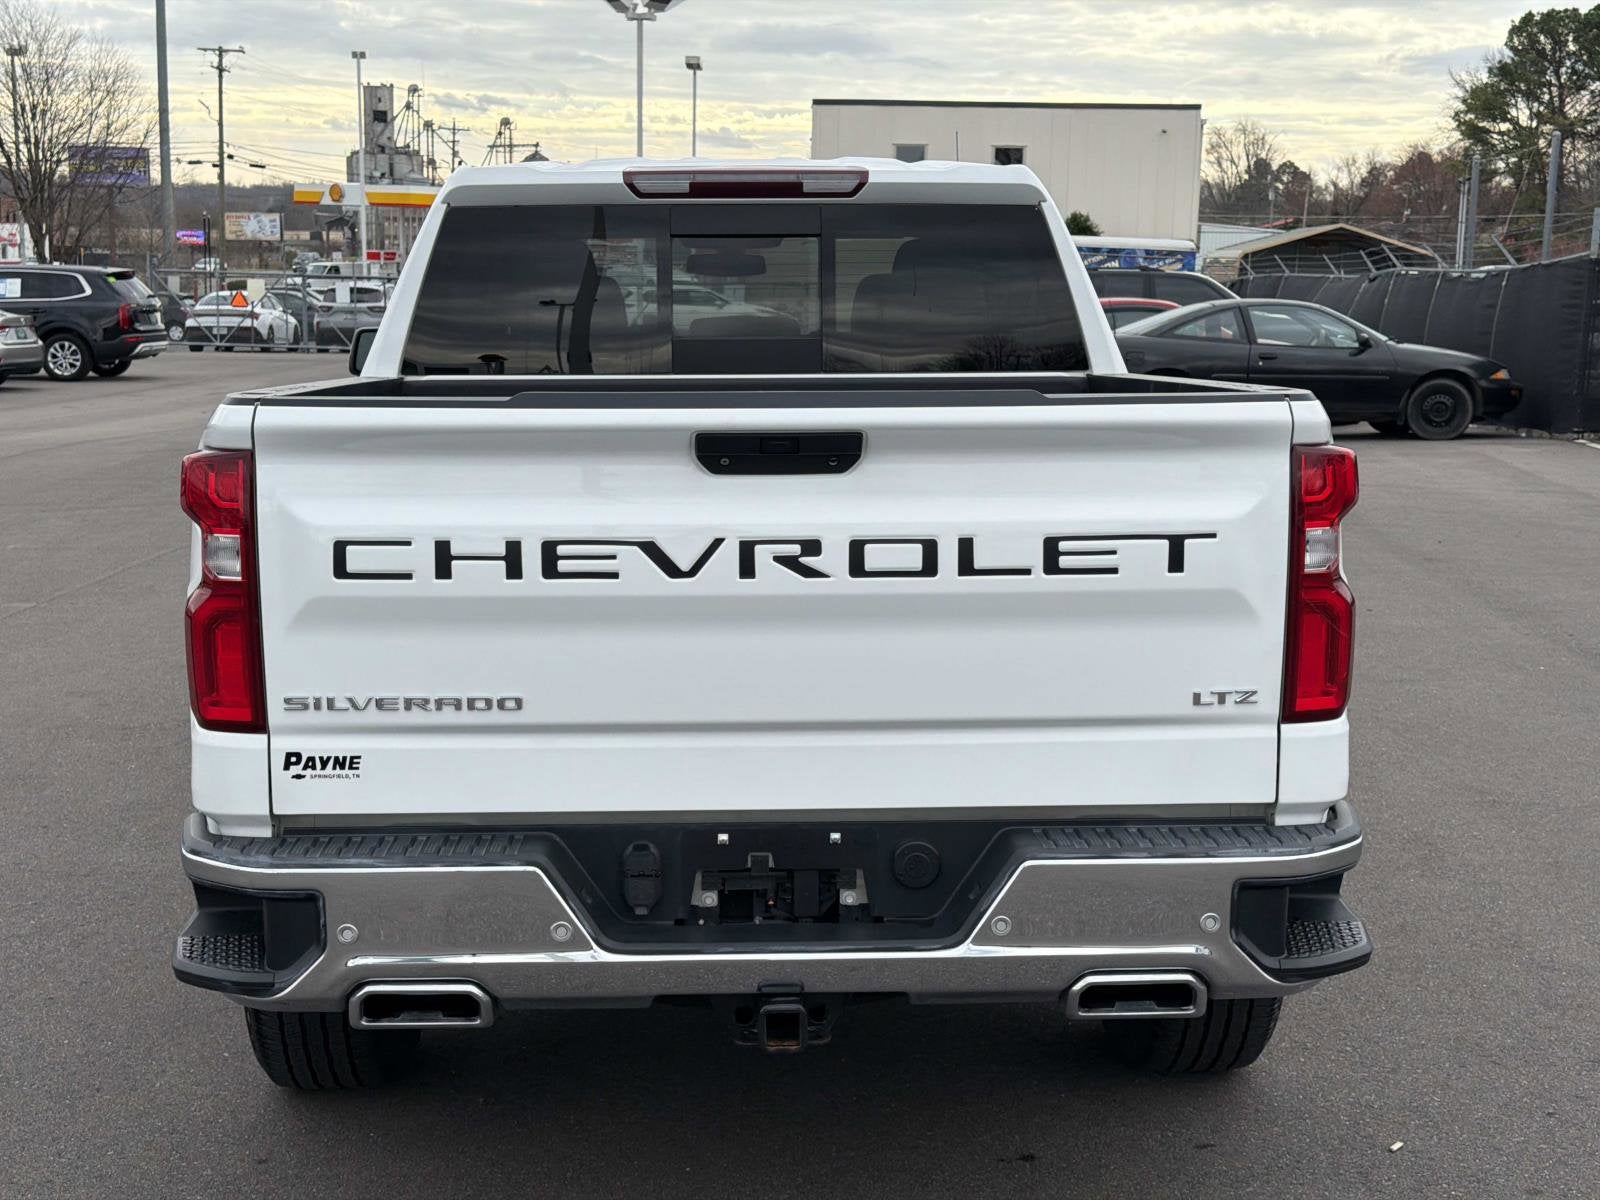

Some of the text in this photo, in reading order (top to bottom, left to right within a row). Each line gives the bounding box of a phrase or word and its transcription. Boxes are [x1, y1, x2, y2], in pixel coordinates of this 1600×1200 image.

[333, 532, 1217, 580] CHEVROLET
[283, 695, 524, 712] SILVERADO
[1192, 689, 1259, 706] LTZ
[282, 751, 362, 771] PAYNE
